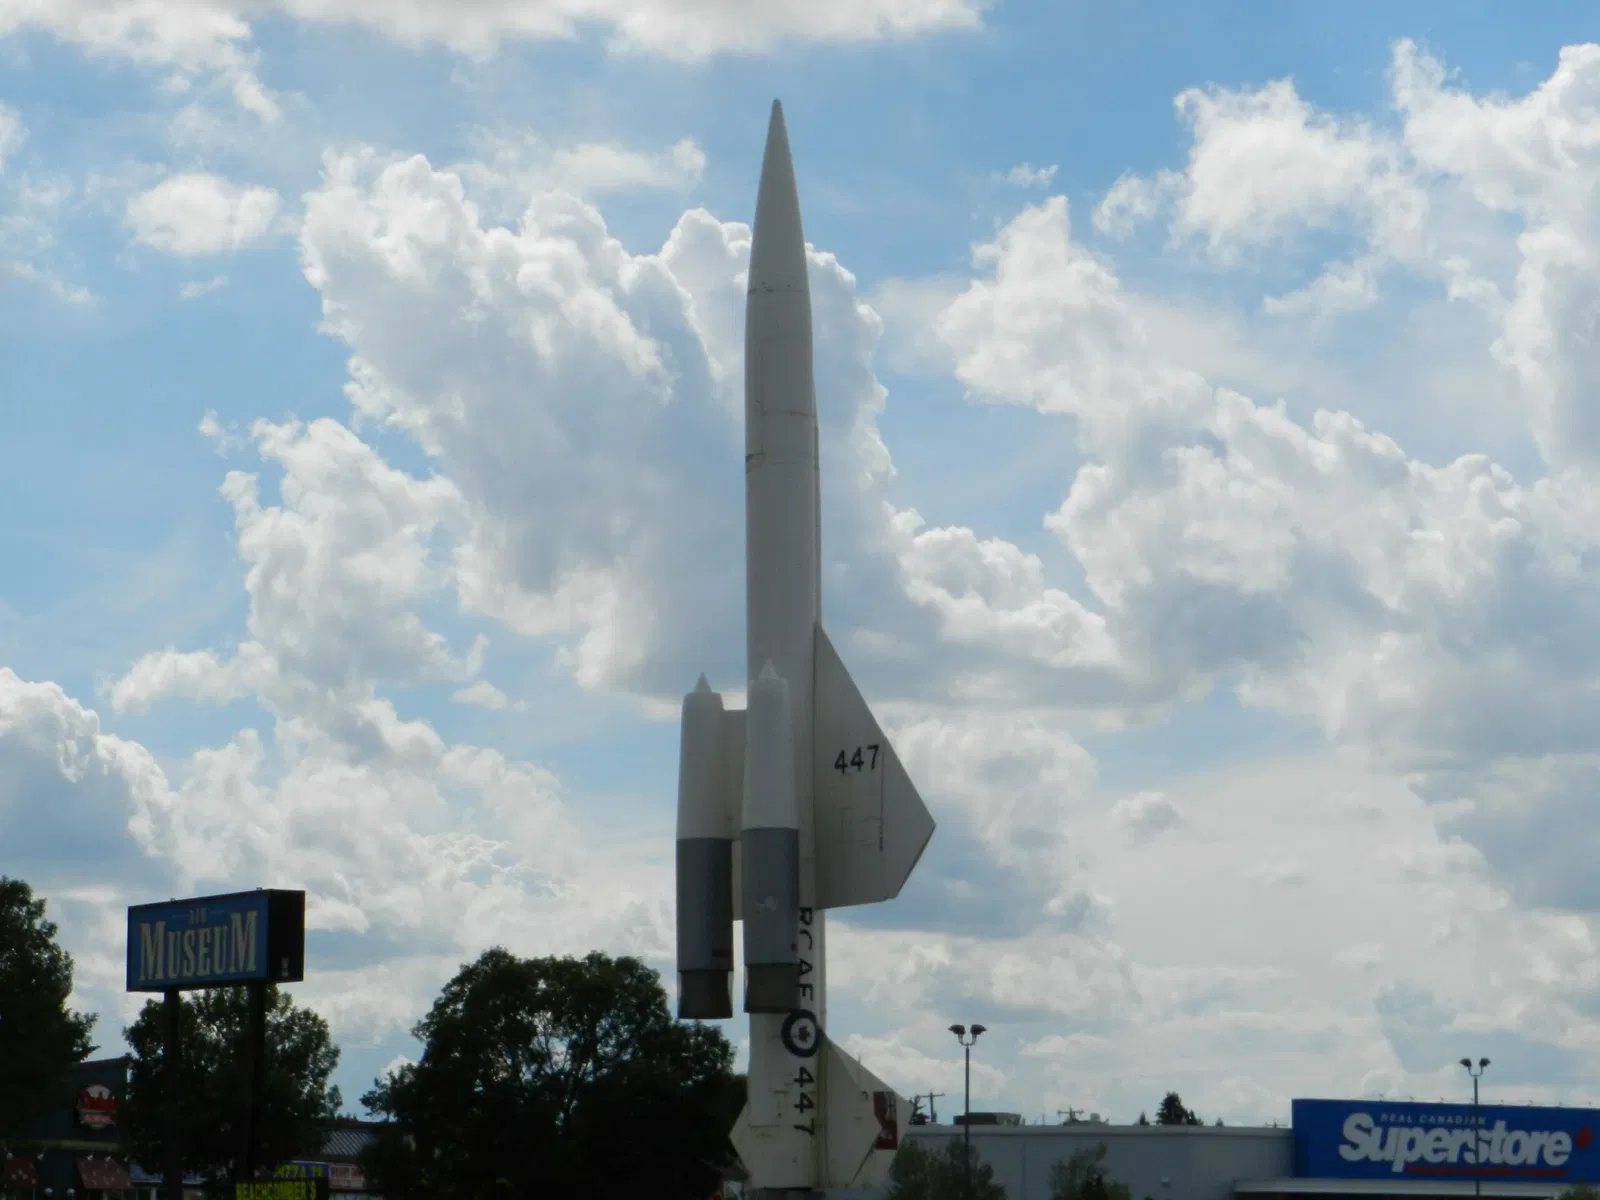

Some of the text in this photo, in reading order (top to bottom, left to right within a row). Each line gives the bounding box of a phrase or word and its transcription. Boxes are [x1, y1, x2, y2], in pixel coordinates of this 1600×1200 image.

[834, 745, 880, 775] 447
[138, 910, 259, 981] MUSEUM
[794, 907, 815, 1136] RCAF 447
[1338, 1112, 1572, 1173] Superstore
[1380, 1113, 1487, 1126] REAL CANADIAN
